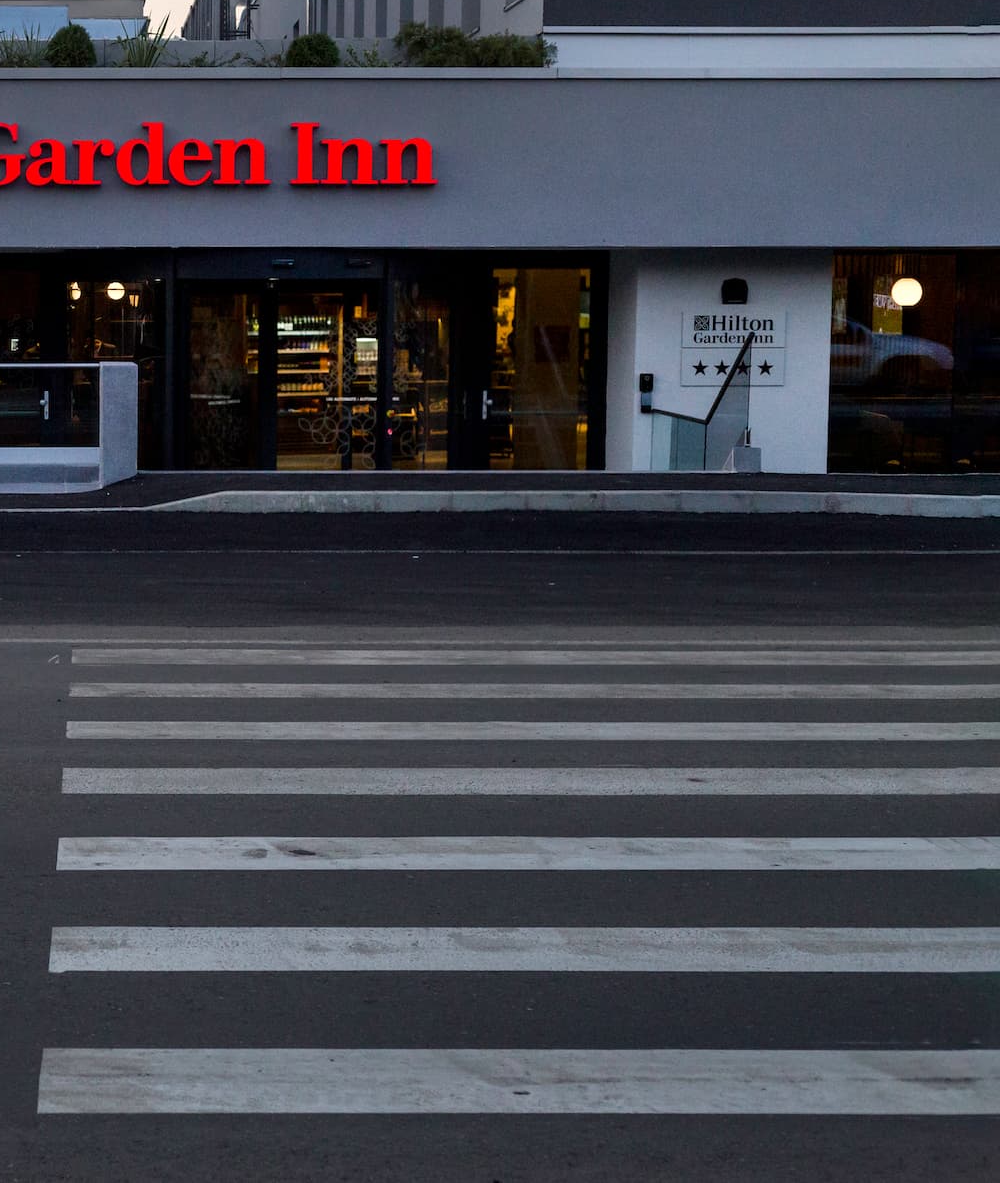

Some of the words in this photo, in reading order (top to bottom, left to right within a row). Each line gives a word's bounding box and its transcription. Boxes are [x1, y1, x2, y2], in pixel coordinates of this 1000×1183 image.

[290, 121, 438, 186] Inn
[712, 315, 773, 331] Hilton
[693, 332, 745, 344] Garden
[746, 332, 773, 343] nn
